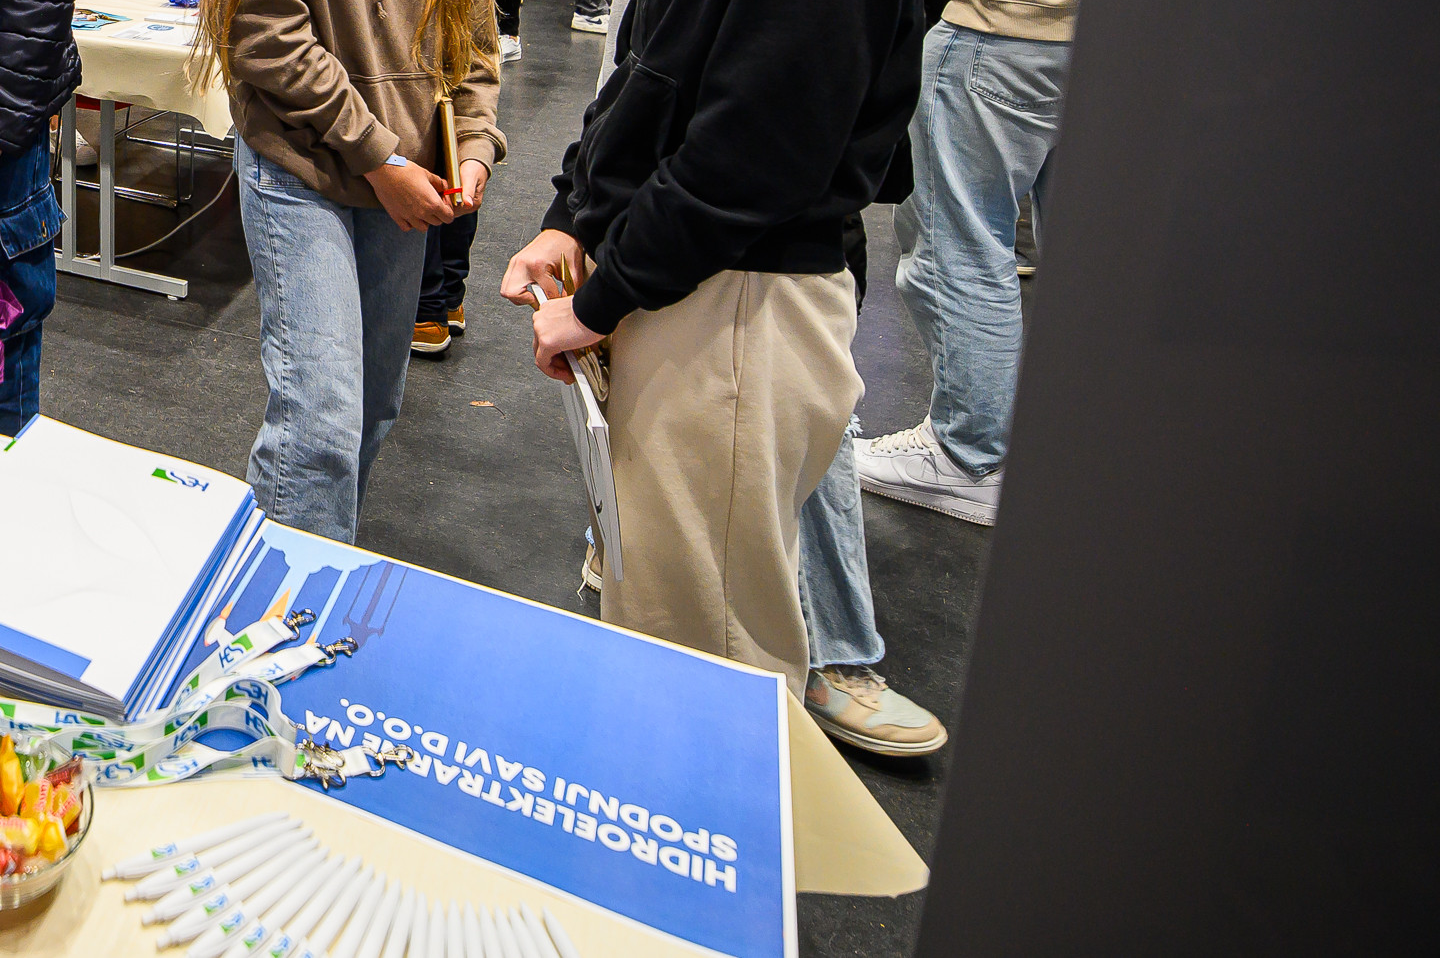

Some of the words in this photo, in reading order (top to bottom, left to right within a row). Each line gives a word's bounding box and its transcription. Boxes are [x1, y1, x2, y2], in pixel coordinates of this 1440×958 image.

[305, 709, 356, 748] NA
[339, 697, 450, 758] D.O.O.
[453, 740, 548, 794] SAVI
[553, 774, 739, 864] SPODNJI
